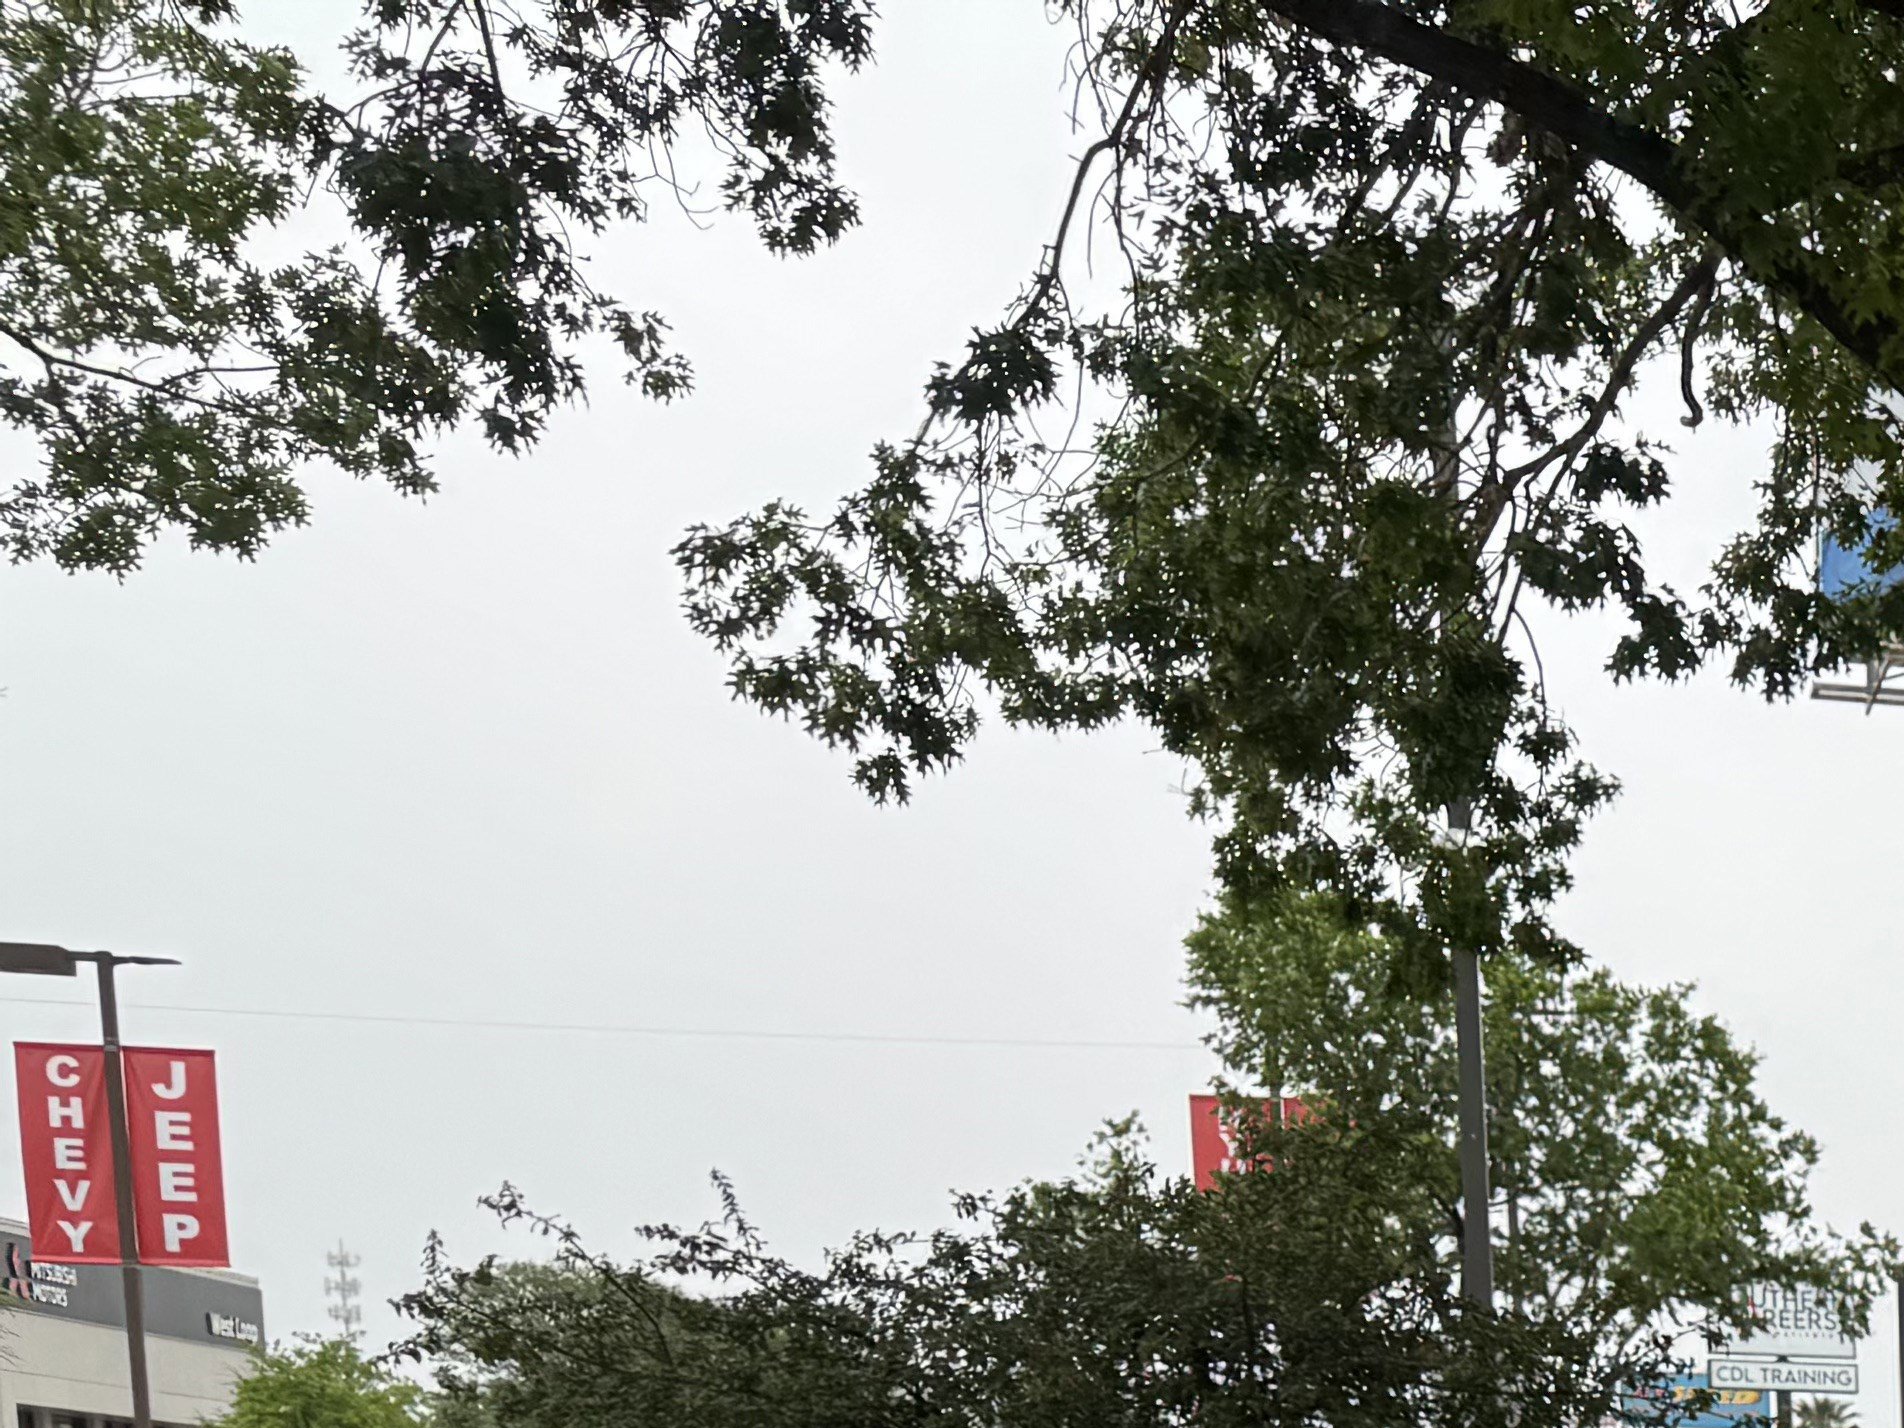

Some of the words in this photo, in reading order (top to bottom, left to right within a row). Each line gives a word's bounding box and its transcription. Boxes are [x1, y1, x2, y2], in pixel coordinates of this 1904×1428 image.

[46, 1055, 93, 1253] CHEVY
[151, 1061, 200, 1252] JEEP
[1716, 1365, 1754, 1383] CDL
[1760, 1367, 1853, 1387] TRAINING
